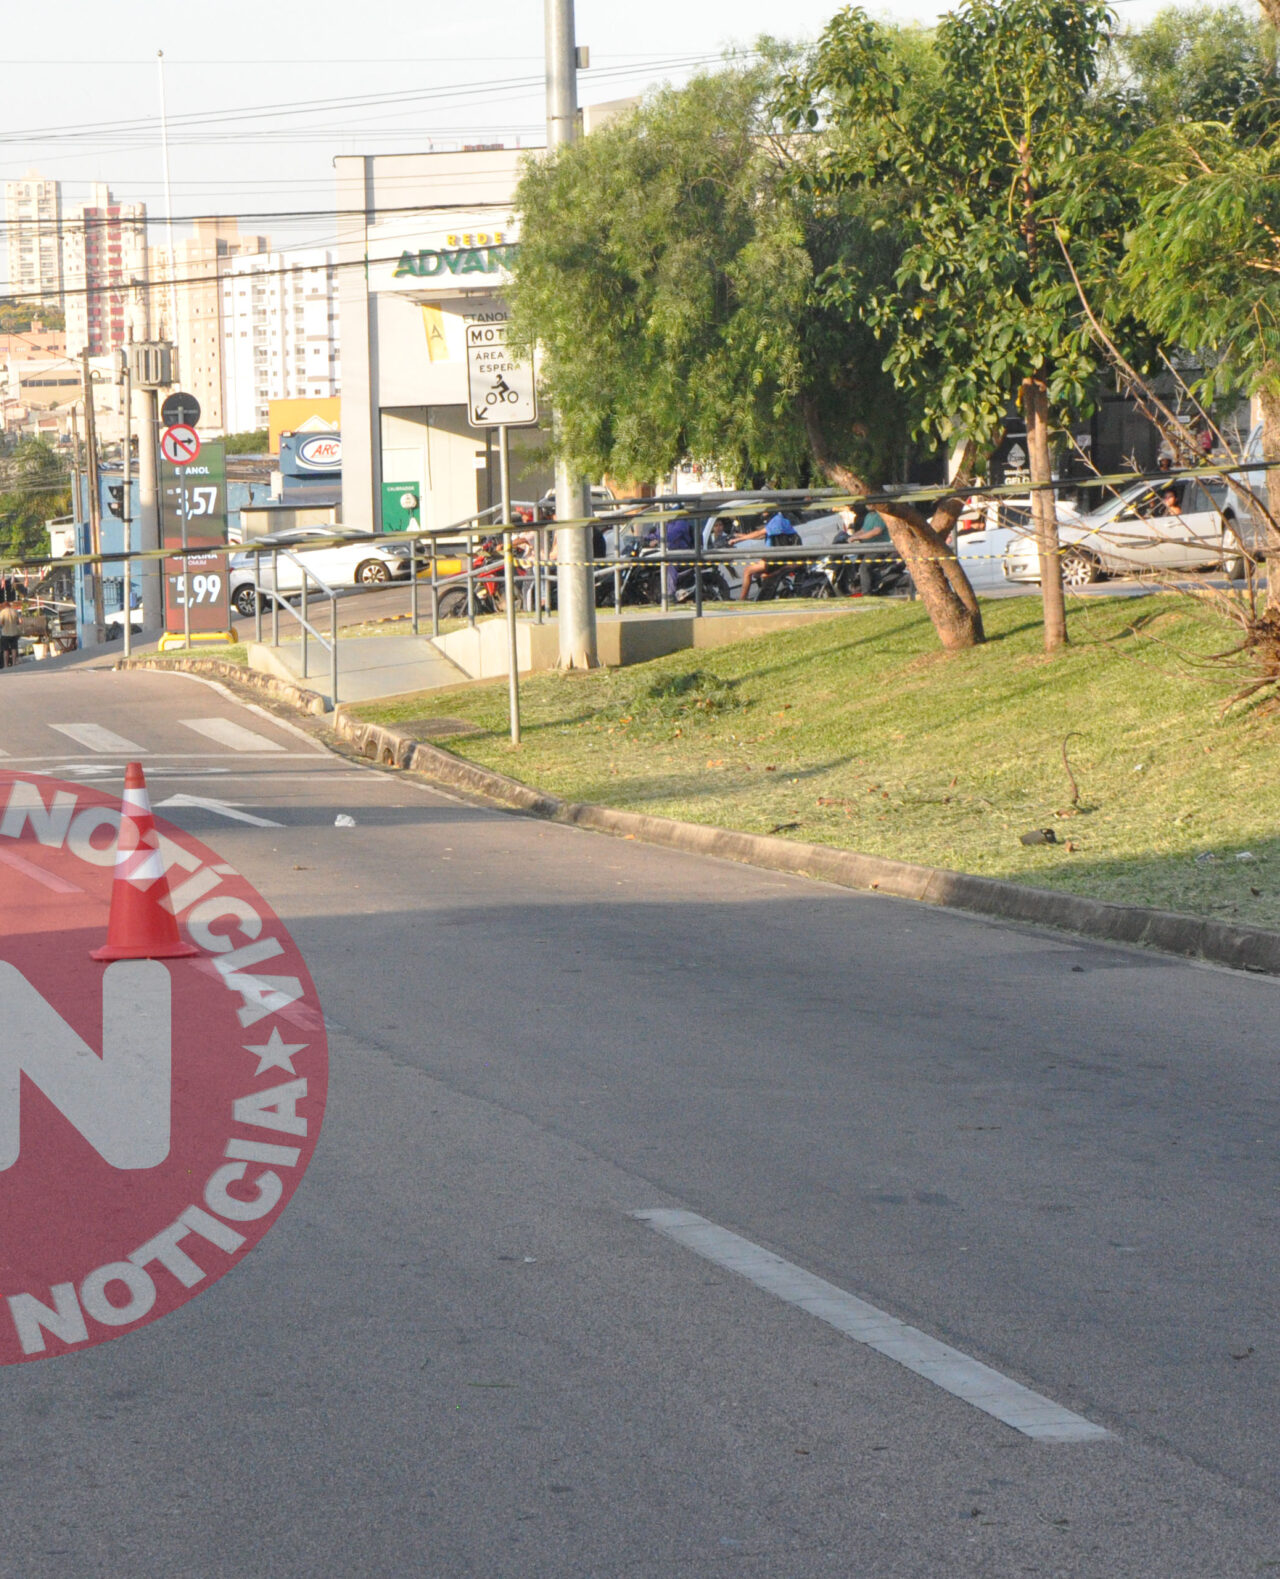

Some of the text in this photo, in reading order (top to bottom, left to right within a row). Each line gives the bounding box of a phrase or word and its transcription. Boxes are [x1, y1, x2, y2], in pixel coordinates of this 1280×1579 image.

[447, 232, 503, 246] REDE
[392, 247, 515, 278] ADVAN
[476, 350, 504, 361] ÁREA
[310, 443, 340, 458] ARC
[175, 466, 210, 475] EANOL
